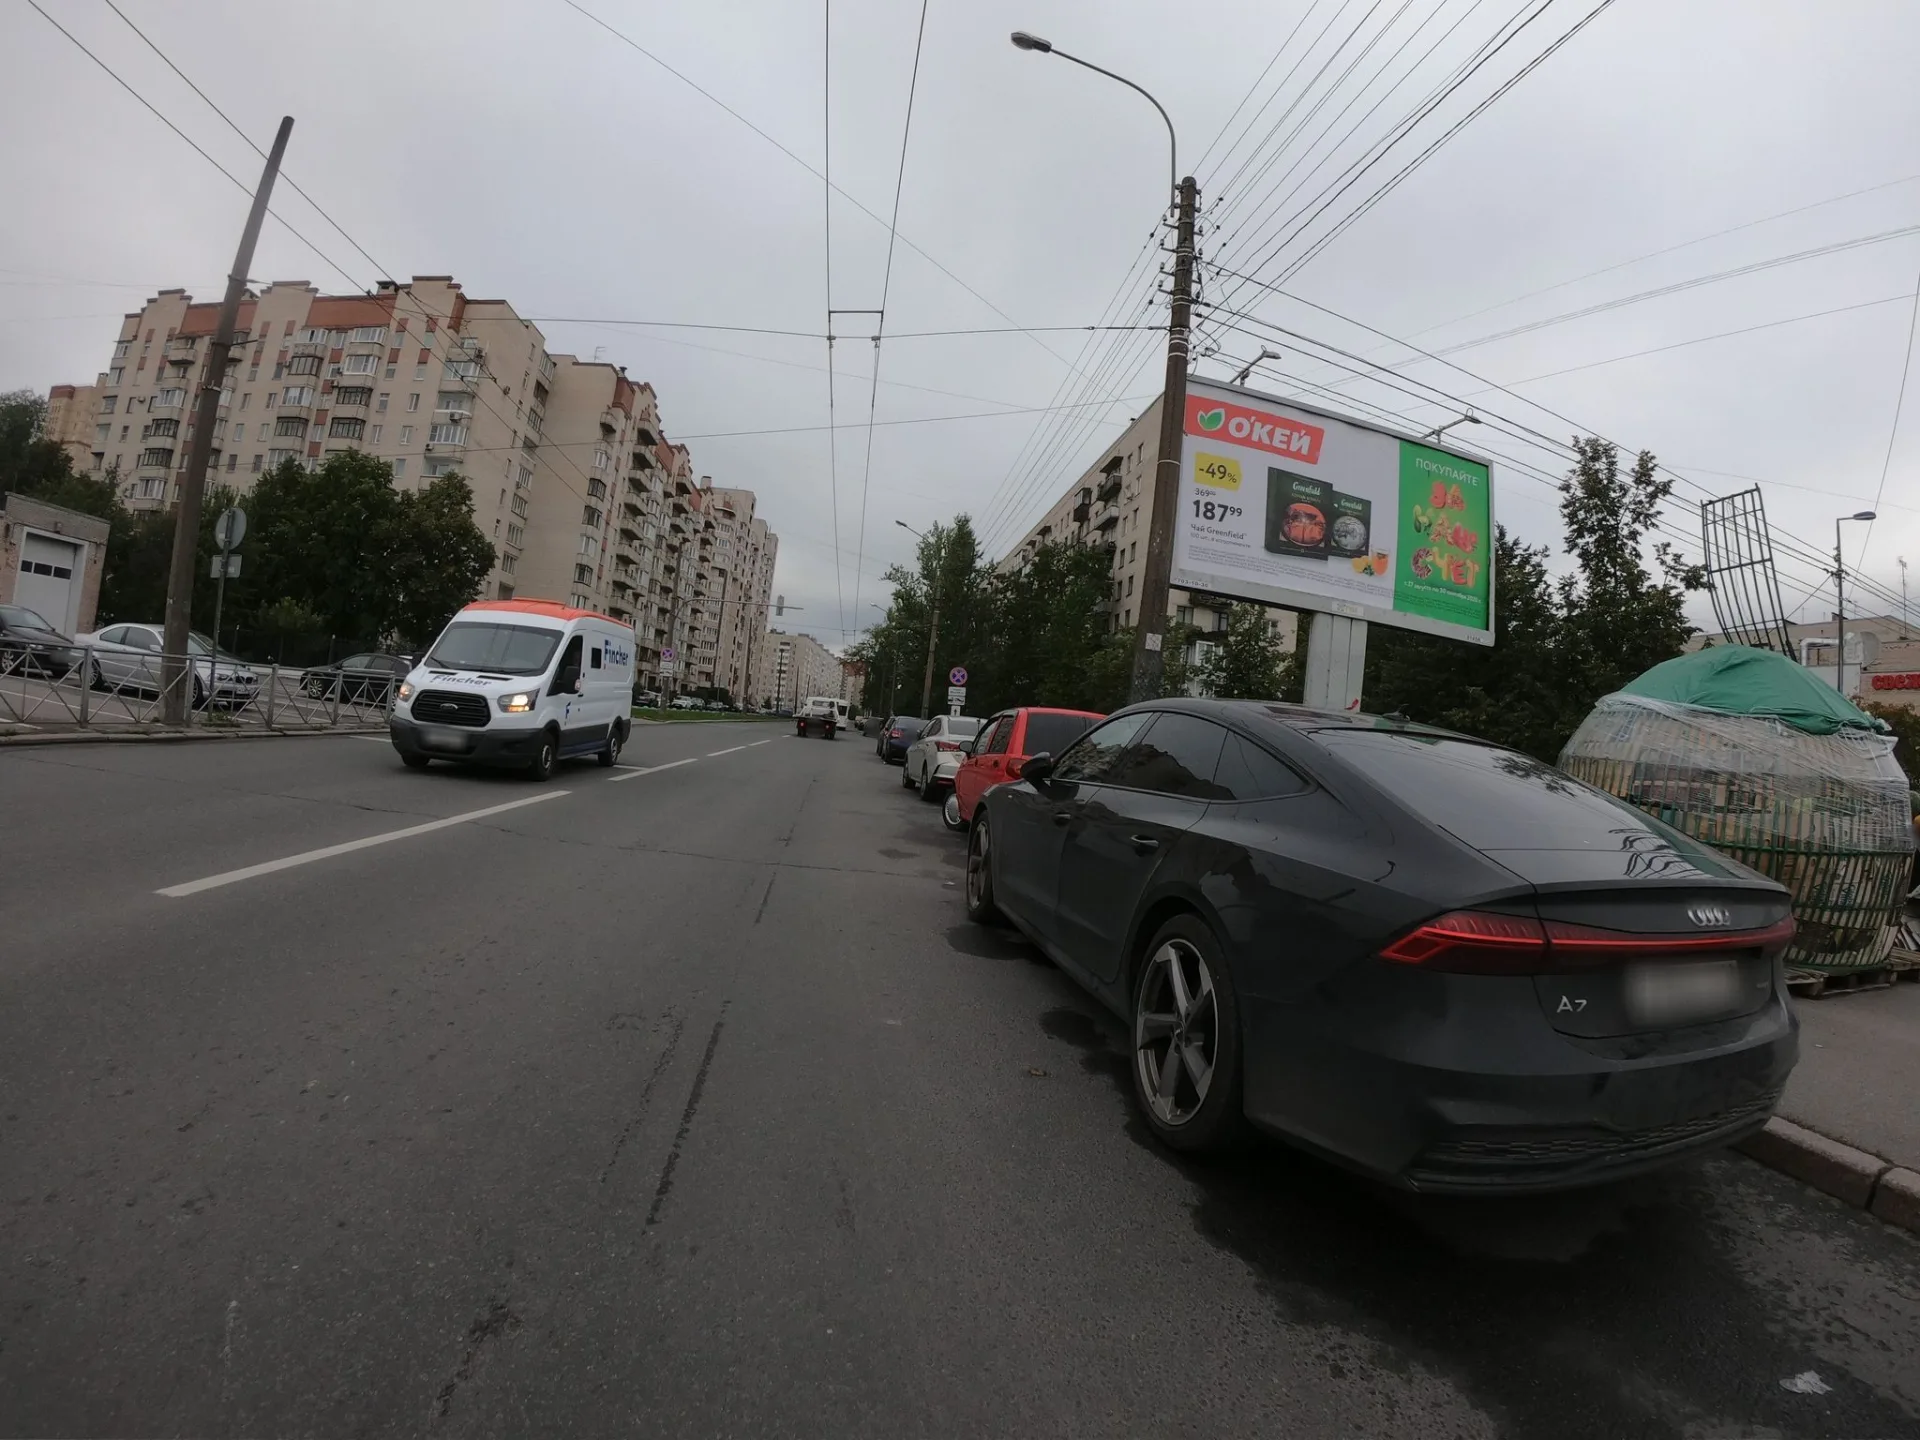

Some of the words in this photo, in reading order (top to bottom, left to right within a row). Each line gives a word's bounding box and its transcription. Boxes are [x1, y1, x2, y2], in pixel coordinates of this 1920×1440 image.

[1228, 416, 1312, 455] О'КЕЙ
[1199, 463, 1237, 483] -49%
[1415, 458, 1479, 486] ПОКУПАЙТЕ
[1429, 481, 1465, 511] ЗА
[1190, 524, 1205, 533] Чай
[1413, 504, 1477, 553] НАШ
[604, 639, 629, 666] Fincher
[432, 673, 492, 687] Fincher
[1557, 995, 1588, 1013] A7
